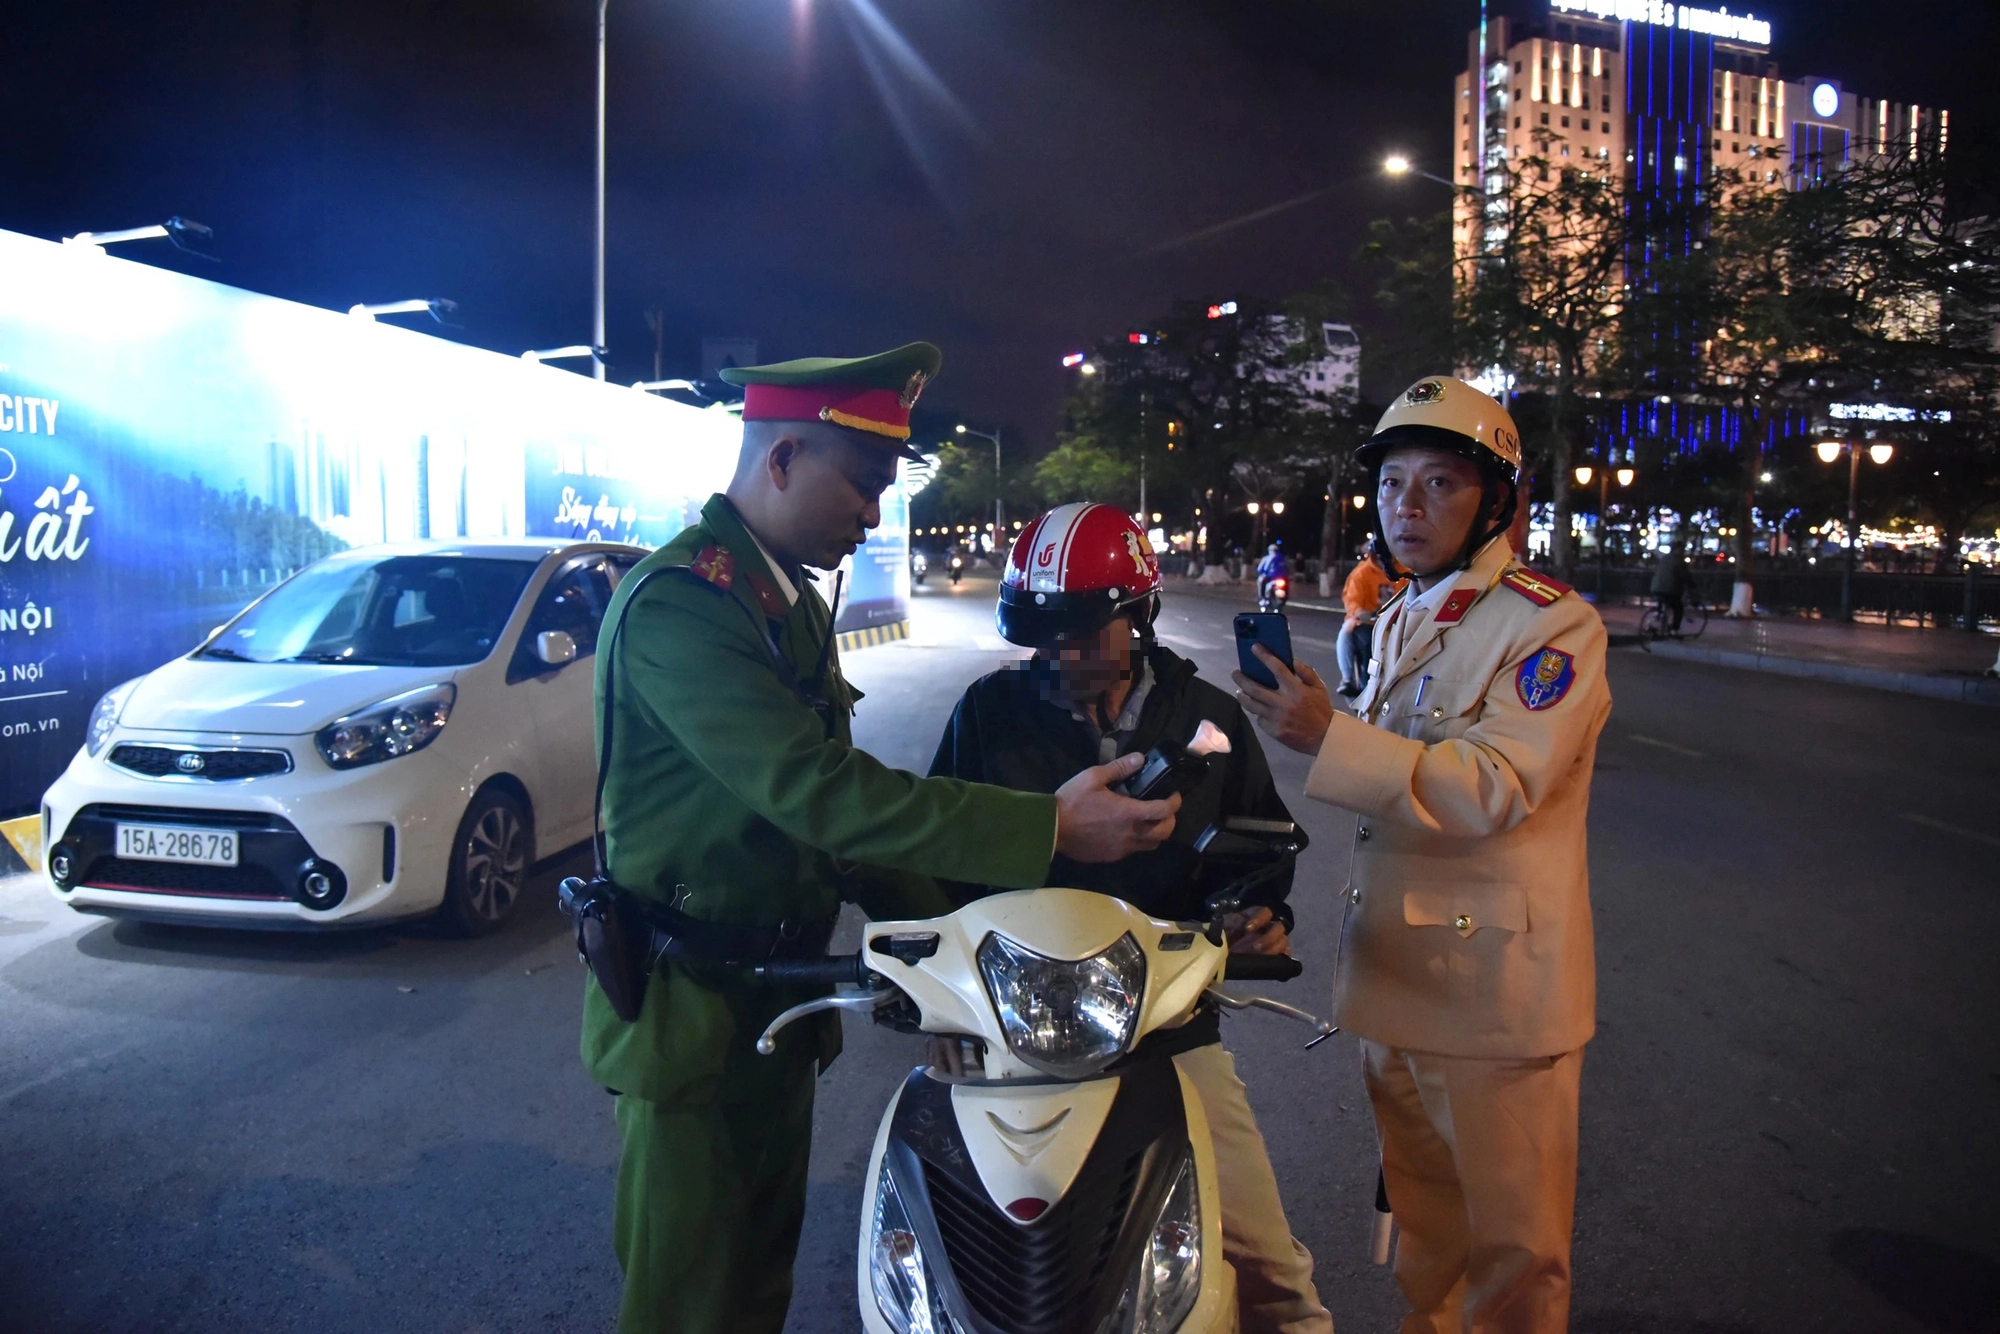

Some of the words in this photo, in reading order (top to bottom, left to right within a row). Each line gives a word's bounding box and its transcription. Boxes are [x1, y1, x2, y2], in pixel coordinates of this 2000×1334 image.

[0, 394, 59, 435] CITY
[0, 601, 52, 636] NỘI
[13, 662, 43, 683] Nội
[1521, 675, 1560, 695] CSGT
[122, 828, 232, 861] 15A-286.78
